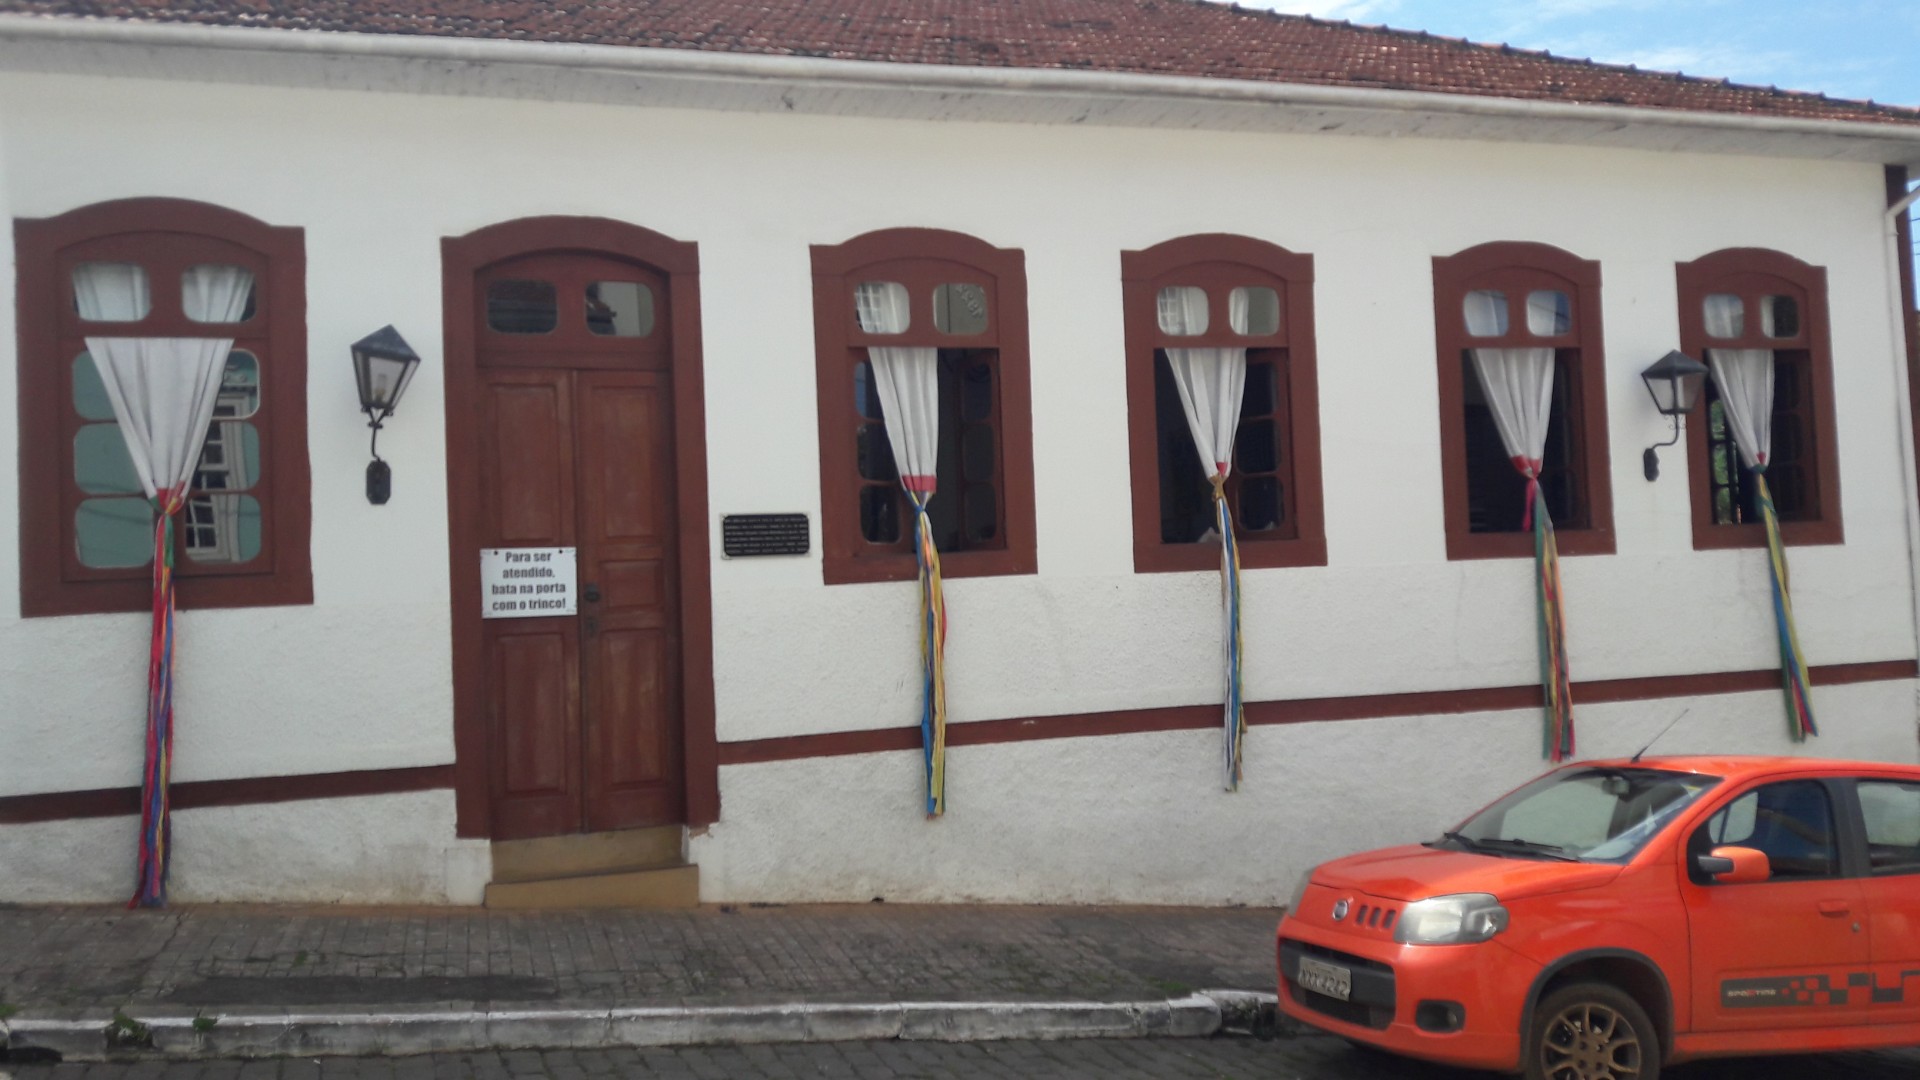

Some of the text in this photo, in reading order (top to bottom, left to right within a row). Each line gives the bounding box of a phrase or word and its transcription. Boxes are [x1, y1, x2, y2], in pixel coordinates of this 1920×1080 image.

[505, 552, 552, 563] Para ser
[492, 583, 566, 595] bata na porta
[492, 598, 566, 611] com o trinco!
